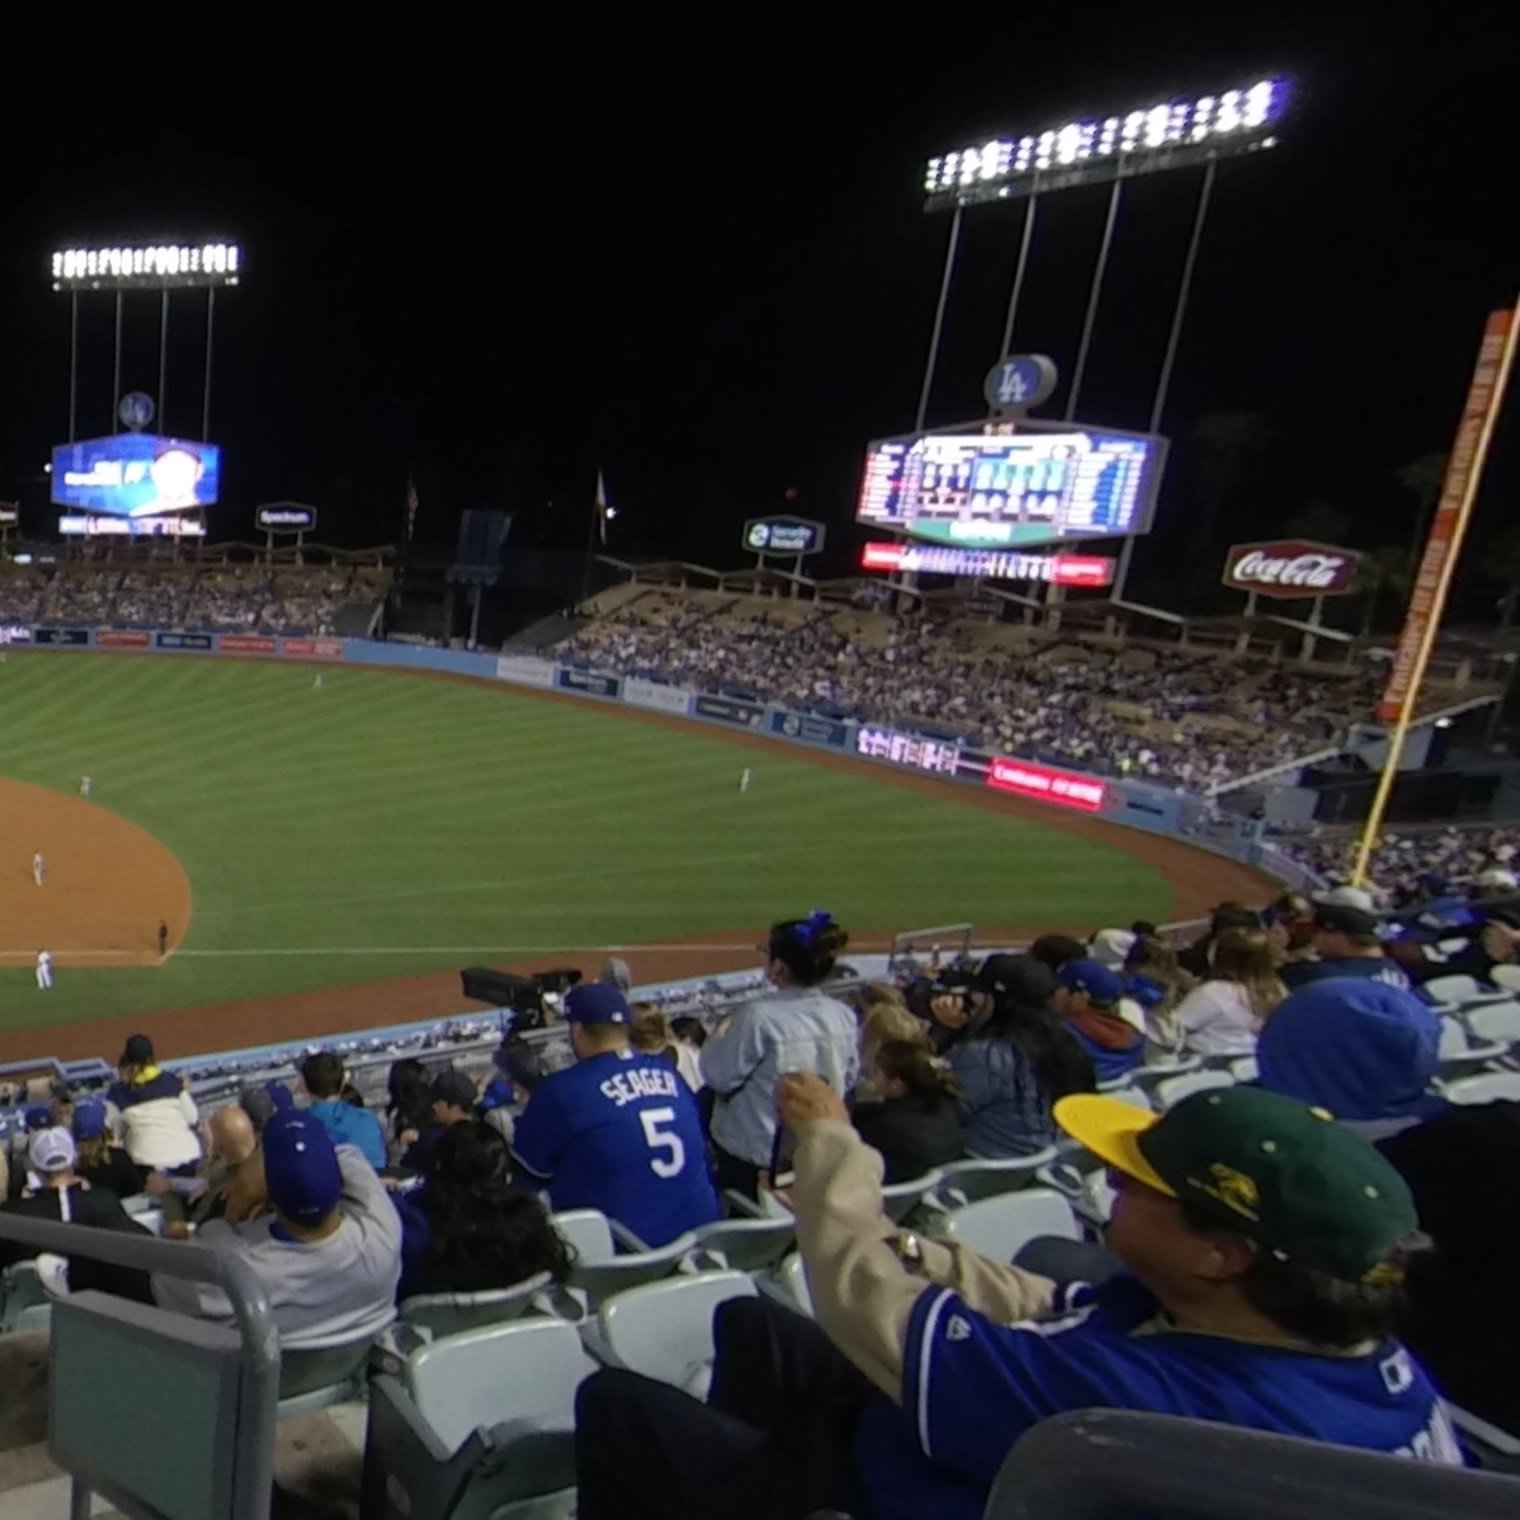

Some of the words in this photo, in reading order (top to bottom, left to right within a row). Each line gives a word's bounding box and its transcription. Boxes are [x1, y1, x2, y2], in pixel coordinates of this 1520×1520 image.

[998, 363, 1028, 403] LA
[600, 1067, 679, 1106] SEAGER
[639, 1107, 686, 1179] 5
